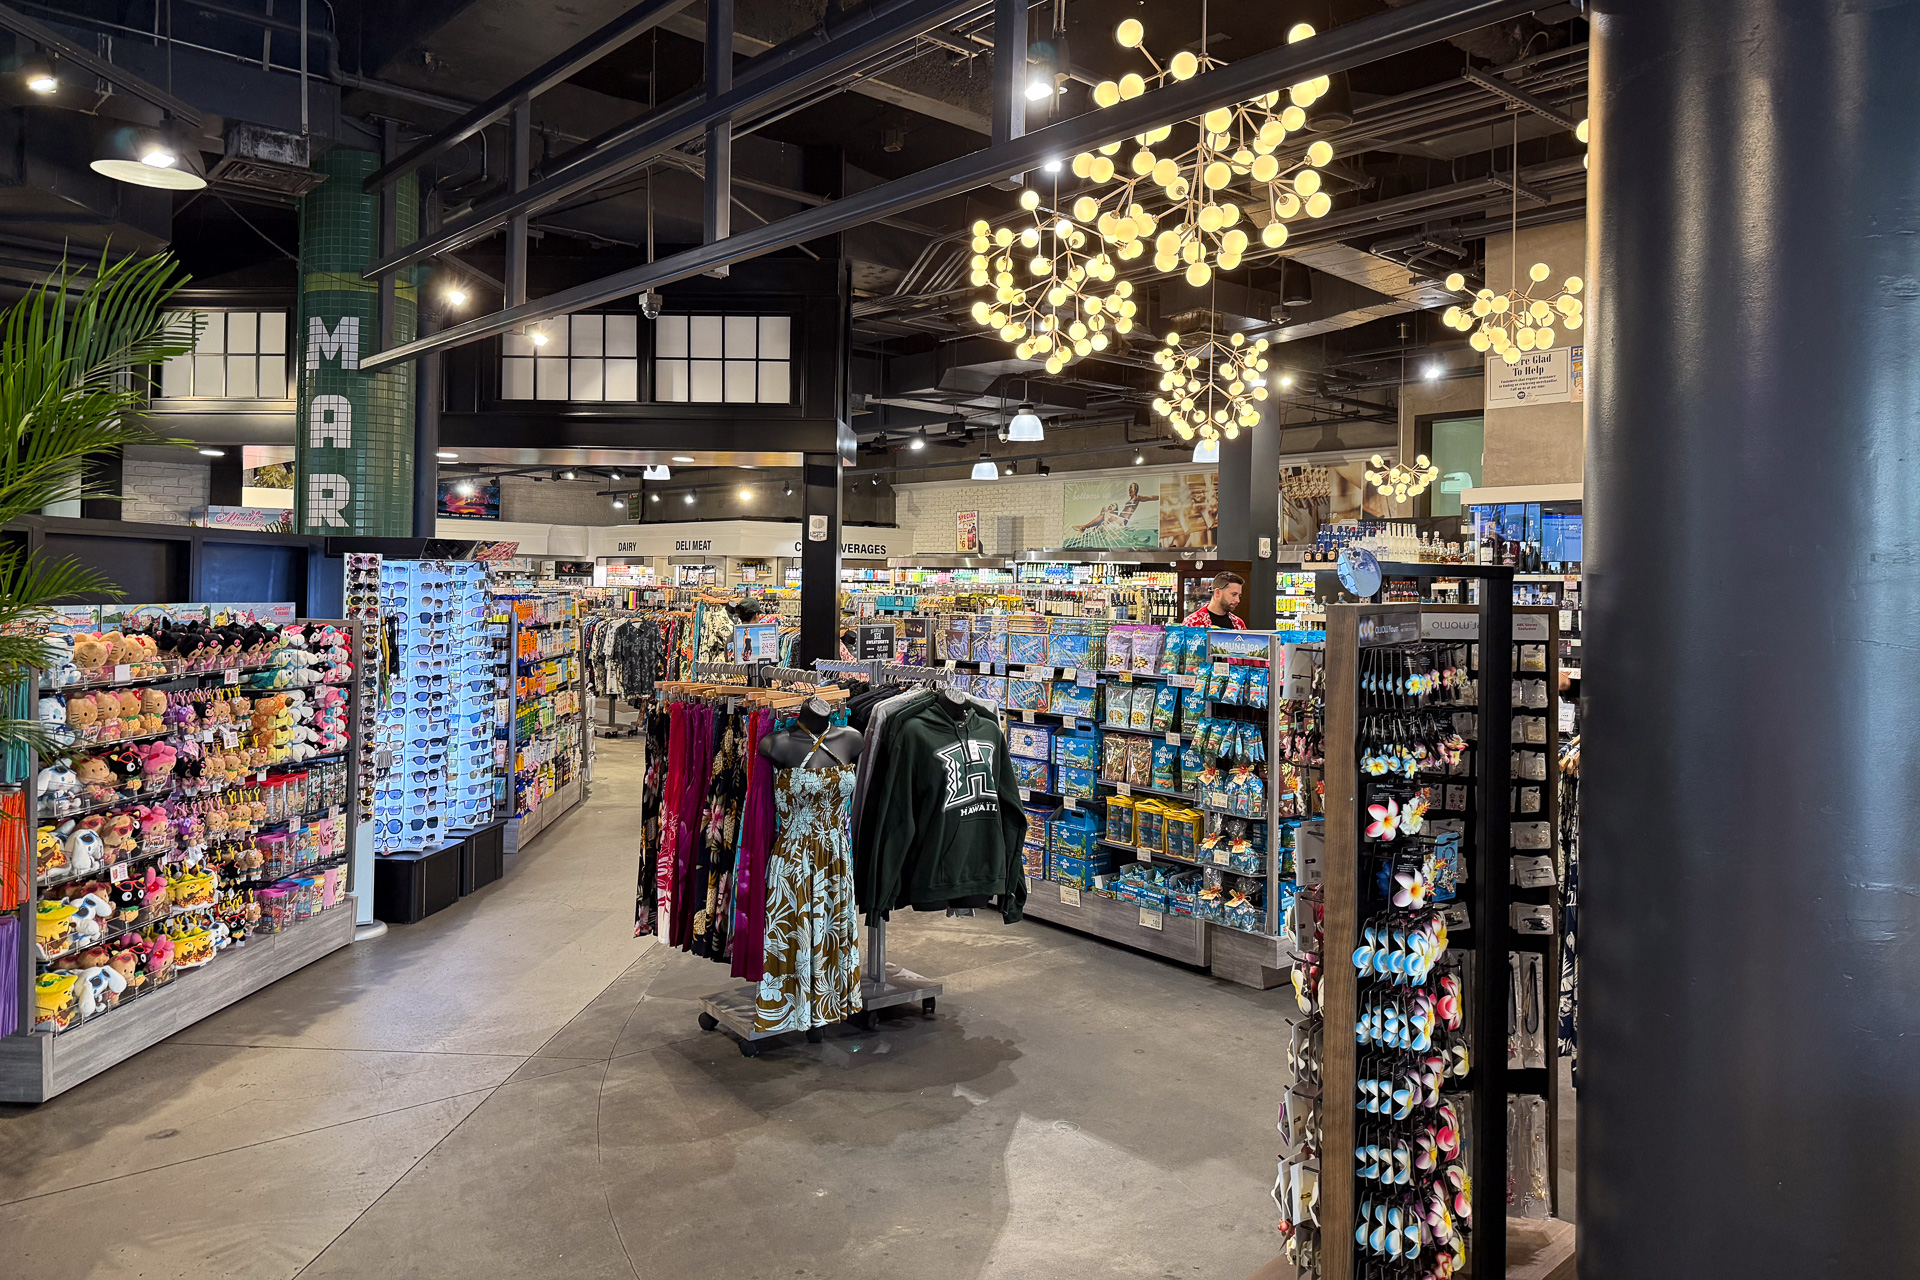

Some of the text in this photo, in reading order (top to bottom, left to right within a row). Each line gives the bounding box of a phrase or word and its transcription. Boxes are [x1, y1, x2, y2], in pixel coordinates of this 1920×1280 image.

[1532, 353, 1552, 364] Glad
[1512, 366, 1545, 376] To Help
[1073, 491, 1100, 500] bottoms
[215, 511, 256, 523] Aloha
[958, 511, 976, 521] SPECIAL
[618, 542, 637, 552] DAIRY
[675, 540, 712, 551] DELI MEAT
[1432, 621, 1470, 630] OLUOLU
[1217, 641, 1260, 652] MAUNA LOA
